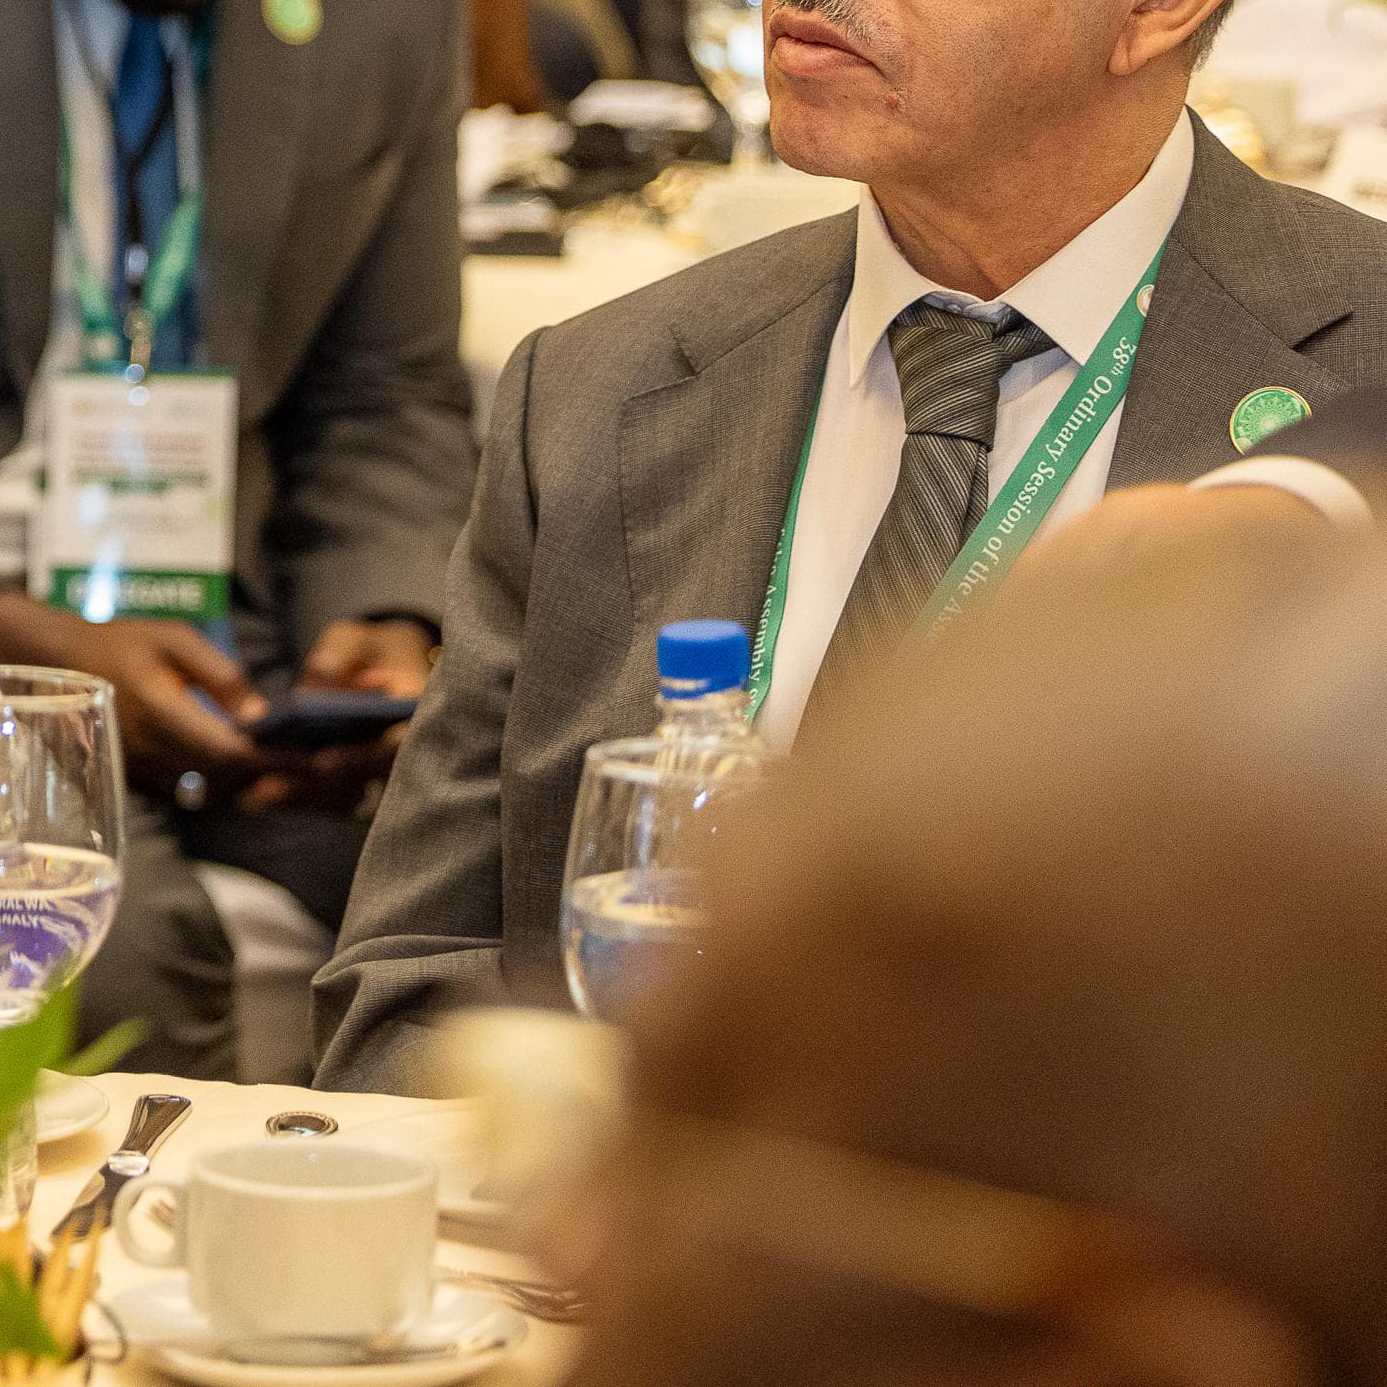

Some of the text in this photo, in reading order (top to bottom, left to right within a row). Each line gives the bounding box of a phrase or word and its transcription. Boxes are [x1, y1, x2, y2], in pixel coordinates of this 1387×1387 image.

[1045, 375, 1113, 462] Ordinary
[997, 461, 1056, 534] Session
[981, 536, 1003, 565] of
[957, 561, 990, 595] the
